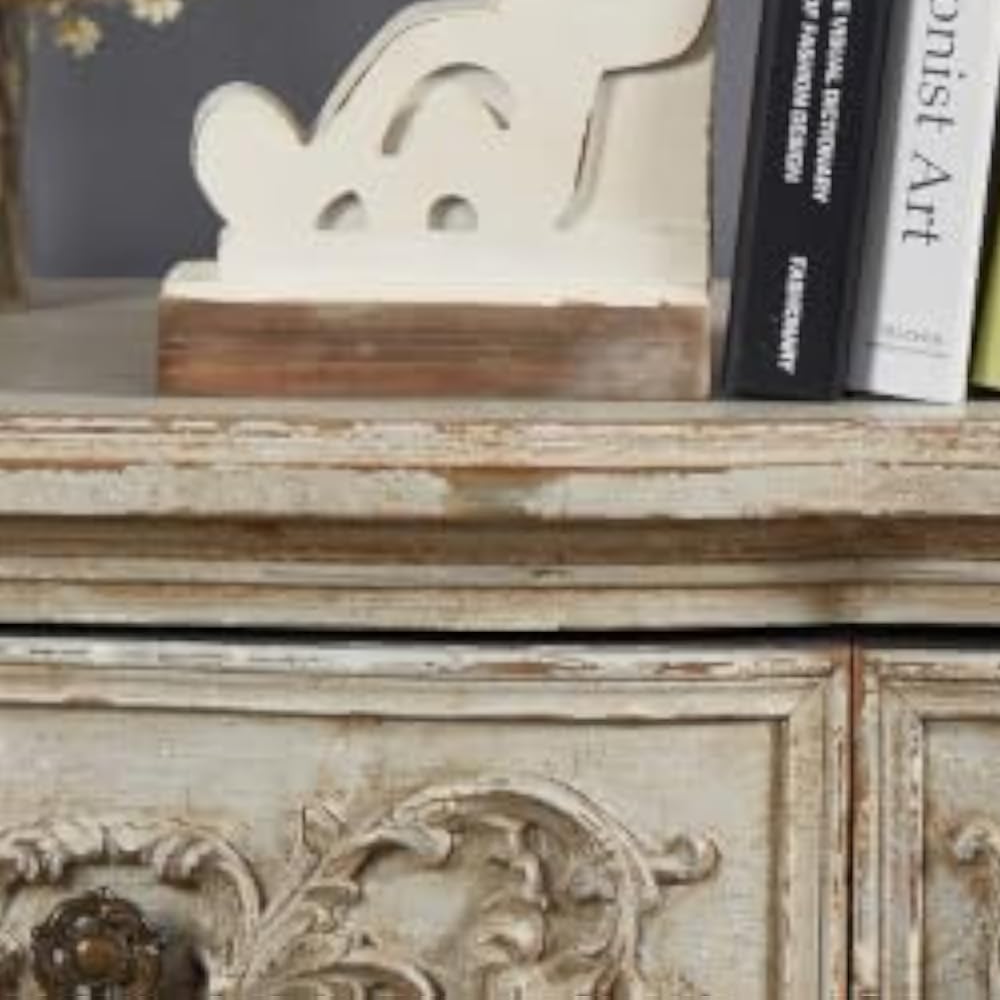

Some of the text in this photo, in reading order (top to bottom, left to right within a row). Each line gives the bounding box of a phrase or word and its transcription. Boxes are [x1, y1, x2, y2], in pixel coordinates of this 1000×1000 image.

[792, 21, 819, 107] FASHION
[812, 88, 841, 203] DICTIONARY
[901, 150, 953, 247] Art
